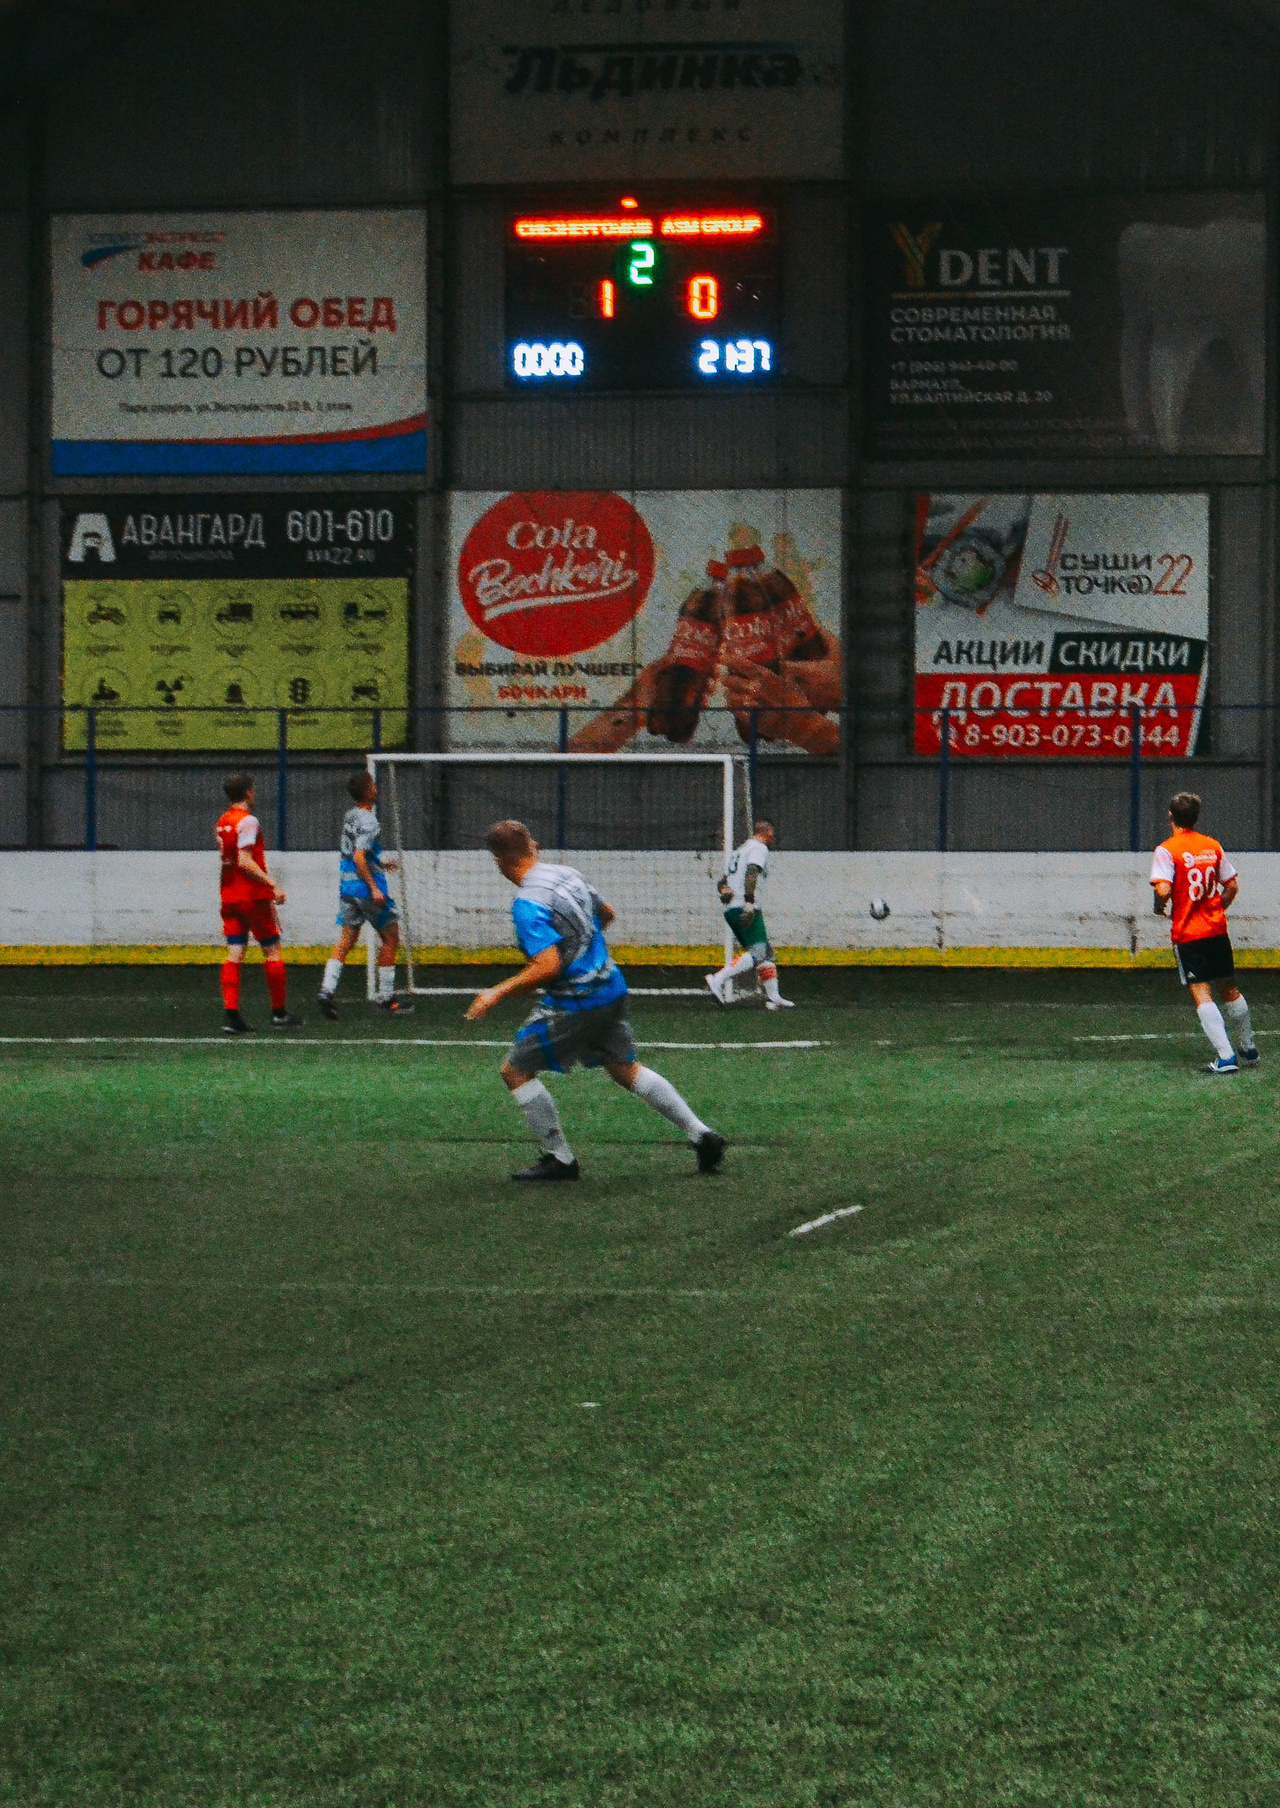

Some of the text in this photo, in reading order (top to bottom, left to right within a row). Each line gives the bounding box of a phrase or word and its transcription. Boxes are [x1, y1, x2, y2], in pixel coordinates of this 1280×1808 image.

[138, 250, 216, 271] КАФЕ
[629, 242, 655, 285] 2
[97, 291, 397, 333] ГОРЯЧИЙ ОБЕД
[601, 279, 614, 318] 1
[689, 276, 718, 320] 0
[890, 306, 1058, 324] СОВРЕМЕННАЯ
[890, 325, 1071, 343] СТОМАТОЛОГИЯ
[97, 340, 378, 379] ОТ 120 РУБЛЕЙ
[121, 513, 266, 548] АВАНГАРД
[286, 509, 394, 542] 601-610
[507, 518, 597, 549] Cola
[1059, 552, 1152, 572] СУШИ
[1152, 554, 1194, 597] 22
[455, 660, 548, 677] ВЫБИРАЙ
[932, 640, 1047, 670] АКЦИИ
[1058, 640, 1190, 671] СКИДКИ
[498, 685, 588, 699] БОЧКАРИ
[932, 681, 1179, 725] ДОСТАВКА
